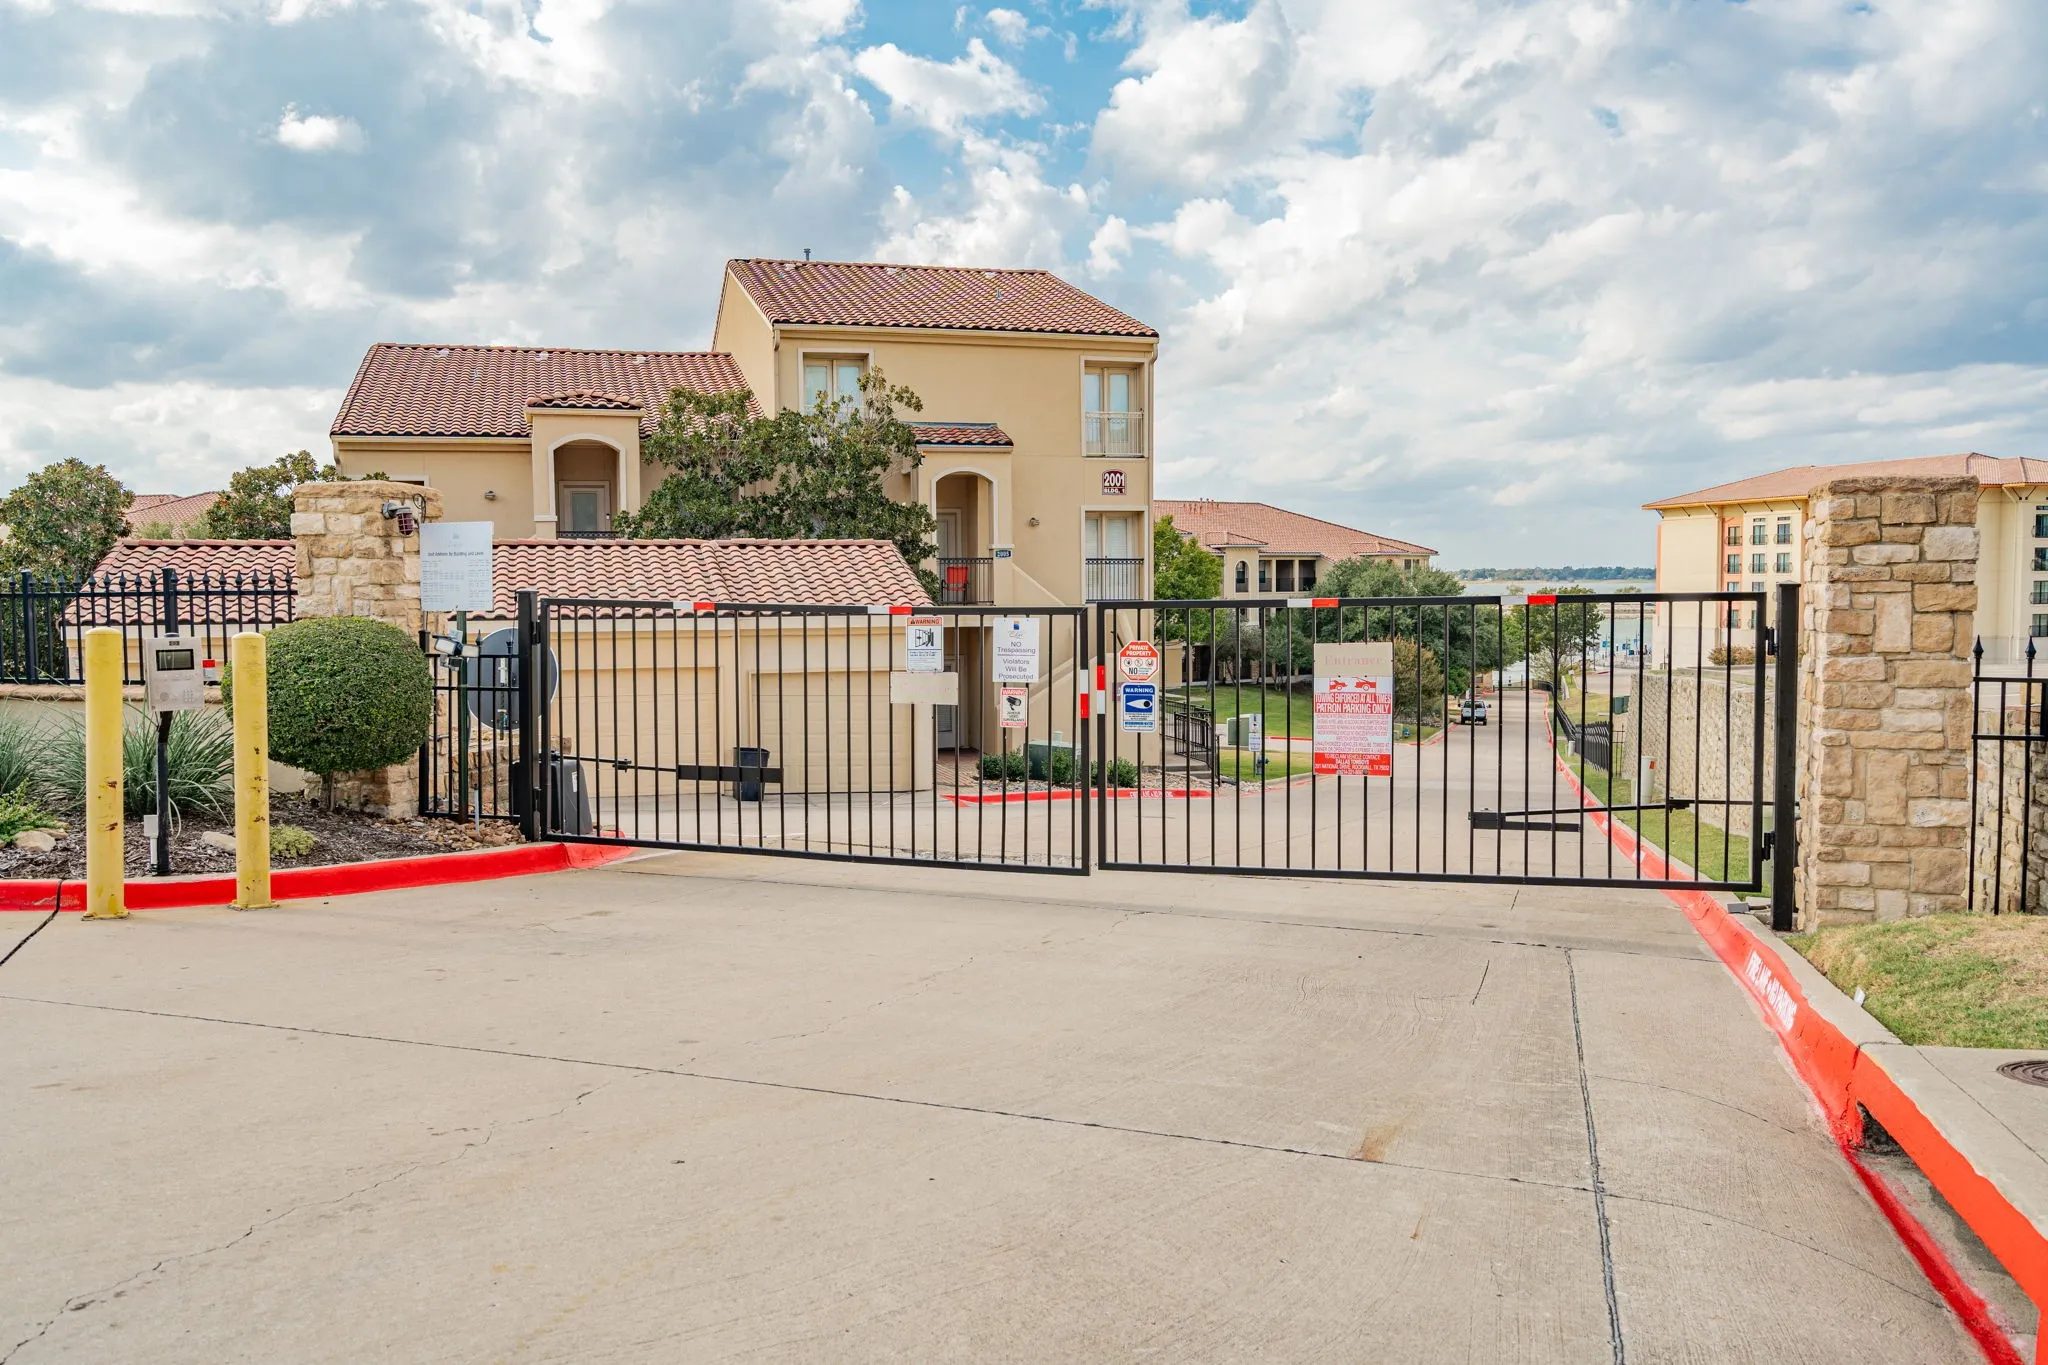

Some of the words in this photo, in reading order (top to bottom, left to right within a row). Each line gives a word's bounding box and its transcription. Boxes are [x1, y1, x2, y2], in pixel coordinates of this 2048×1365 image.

[1104, 472, 1125, 487] 2001
[1315, 693, 1334, 702] TOWING
[1335, 693, 1359, 703] ENFORCED
[1376, 694, 1391, 704] TIMES
[1316, 703, 1341, 713] PATRON
[1343, 704, 1371, 713] PARKING
[1372, 704, 1390, 713] ONLY
